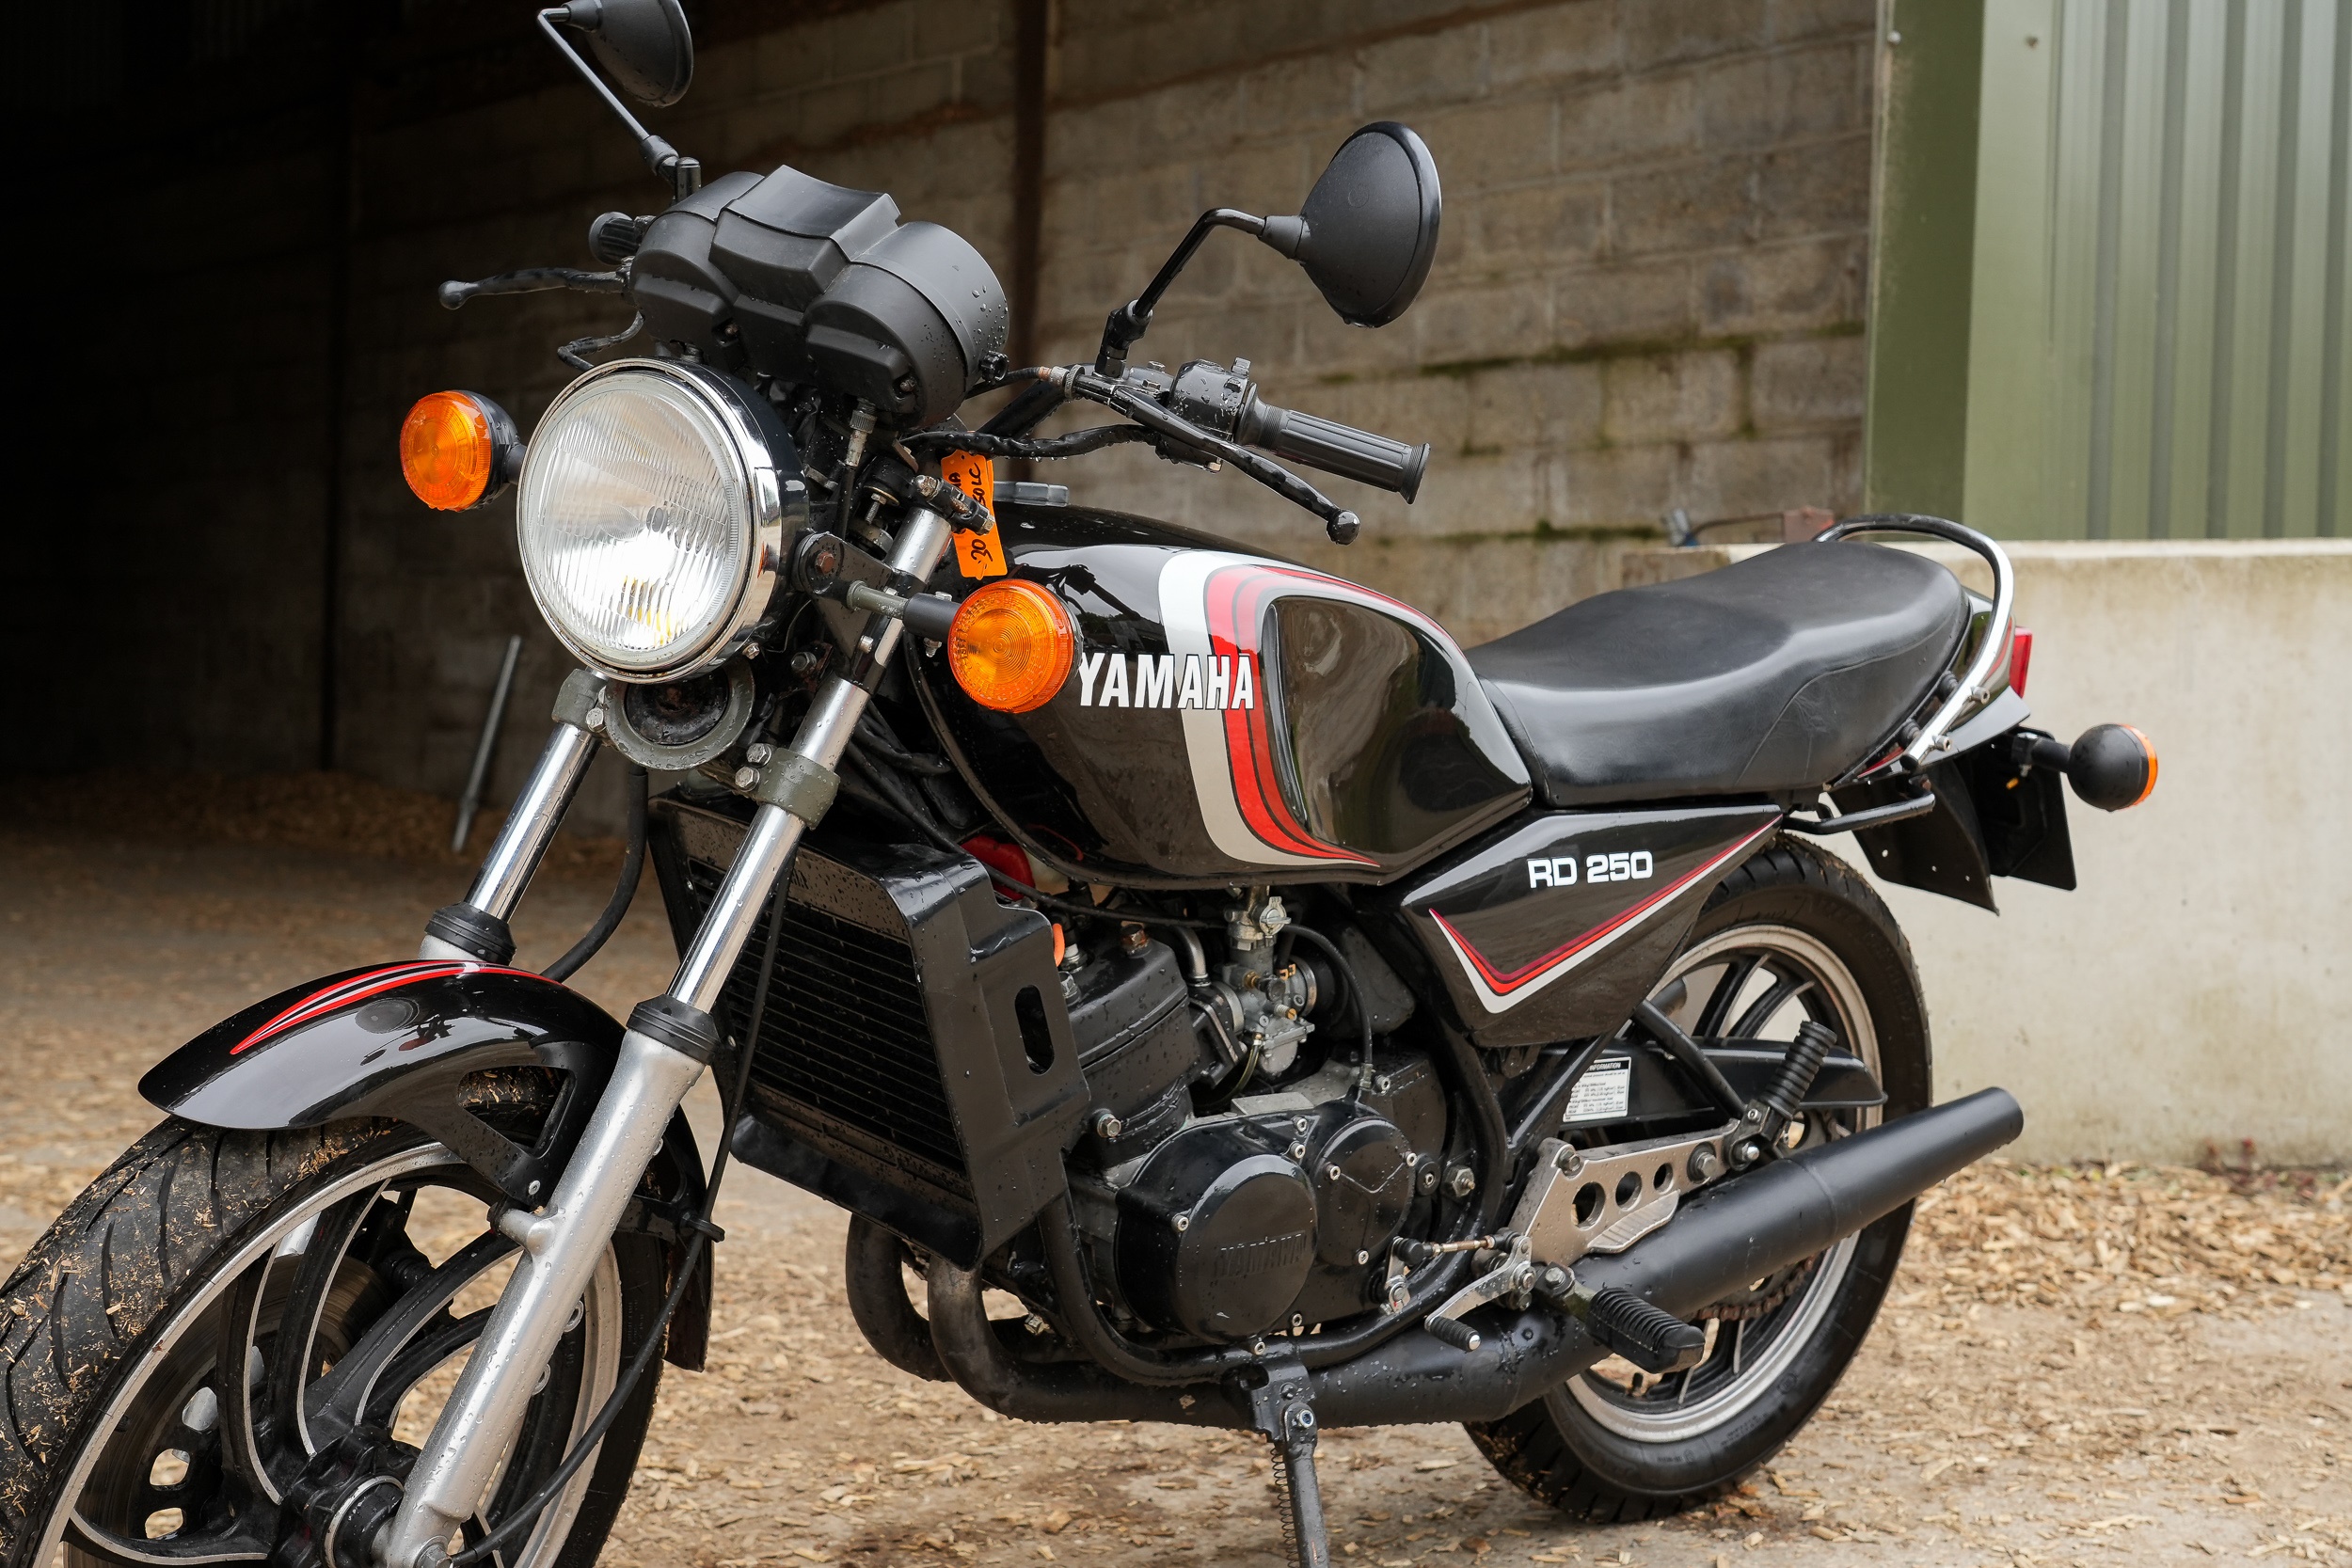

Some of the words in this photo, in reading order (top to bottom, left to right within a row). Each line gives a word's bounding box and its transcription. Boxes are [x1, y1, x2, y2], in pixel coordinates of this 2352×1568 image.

[1078, 652, 1254, 710] YAMAHA
[1527, 857, 1578, 889] RD
[1586, 850, 1654, 884] 250
